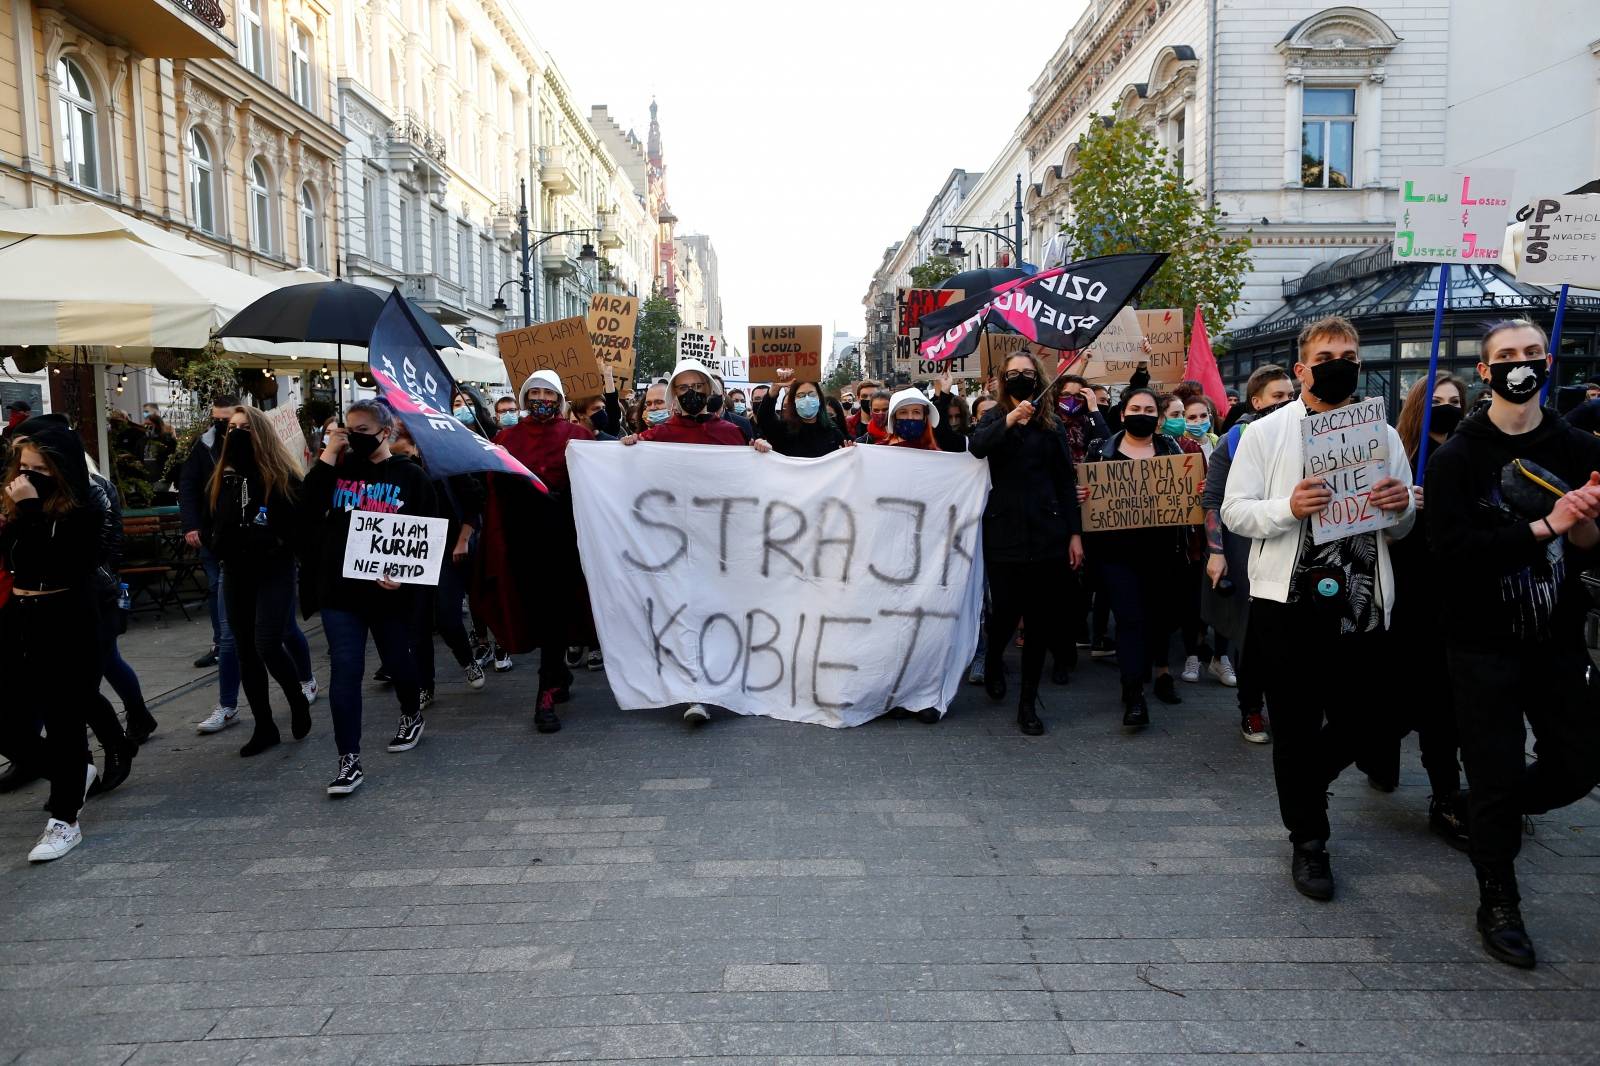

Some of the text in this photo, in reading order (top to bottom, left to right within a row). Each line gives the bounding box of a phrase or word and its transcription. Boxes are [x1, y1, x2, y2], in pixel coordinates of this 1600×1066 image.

[1403, 180, 1449, 203] LAW
[1397, 231, 1500, 259] JUSTICE JERKS
[1525, 241, 1598, 263] SOCIETY
[592, 295, 631, 316] WARA
[596, 316, 620, 332] OD
[751, 327, 796, 340] I WISH
[501, 321, 585, 358] JAK WAM
[681, 332, 704, 342] JAK
[681, 341, 710, 352] MNIE
[751, 342, 802, 353] I COULD
[1145, 332, 1183, 345] ABORT
[511, 347, 579, 379] KURWA
[593, 350, 622, 363] AŁA
[681, 349, 714, 360] NUDZI
[750, 353, 790, 369] ABORT
[561, 372, 602, 396] STYD
[1310, 403, 1385, 436] KACZYŃSKI
[1341, 433, 1346, 444] I
[1310, 439, 1379, 474] BISKUP
[1086, 457, 1175, 483] W NOCY BYŁA
[1322, 466, 1368, 493] NIE
[1091, 477, 1193, 500] ZMIANA CZASU
[1108, 494, 1201, 512] COFNĘLIŚMY SIĘ DO
[1318, 491, 1385, 528] RODZ
[355, 516, 428, 539] JAK WAM
[621, 489, 980, 587] STRAJK
[370, 534, 429, 560] KURWA
[353, 559, 425, 578] NIE WSTYD
[647, 597, 960, 712] KOBIET
